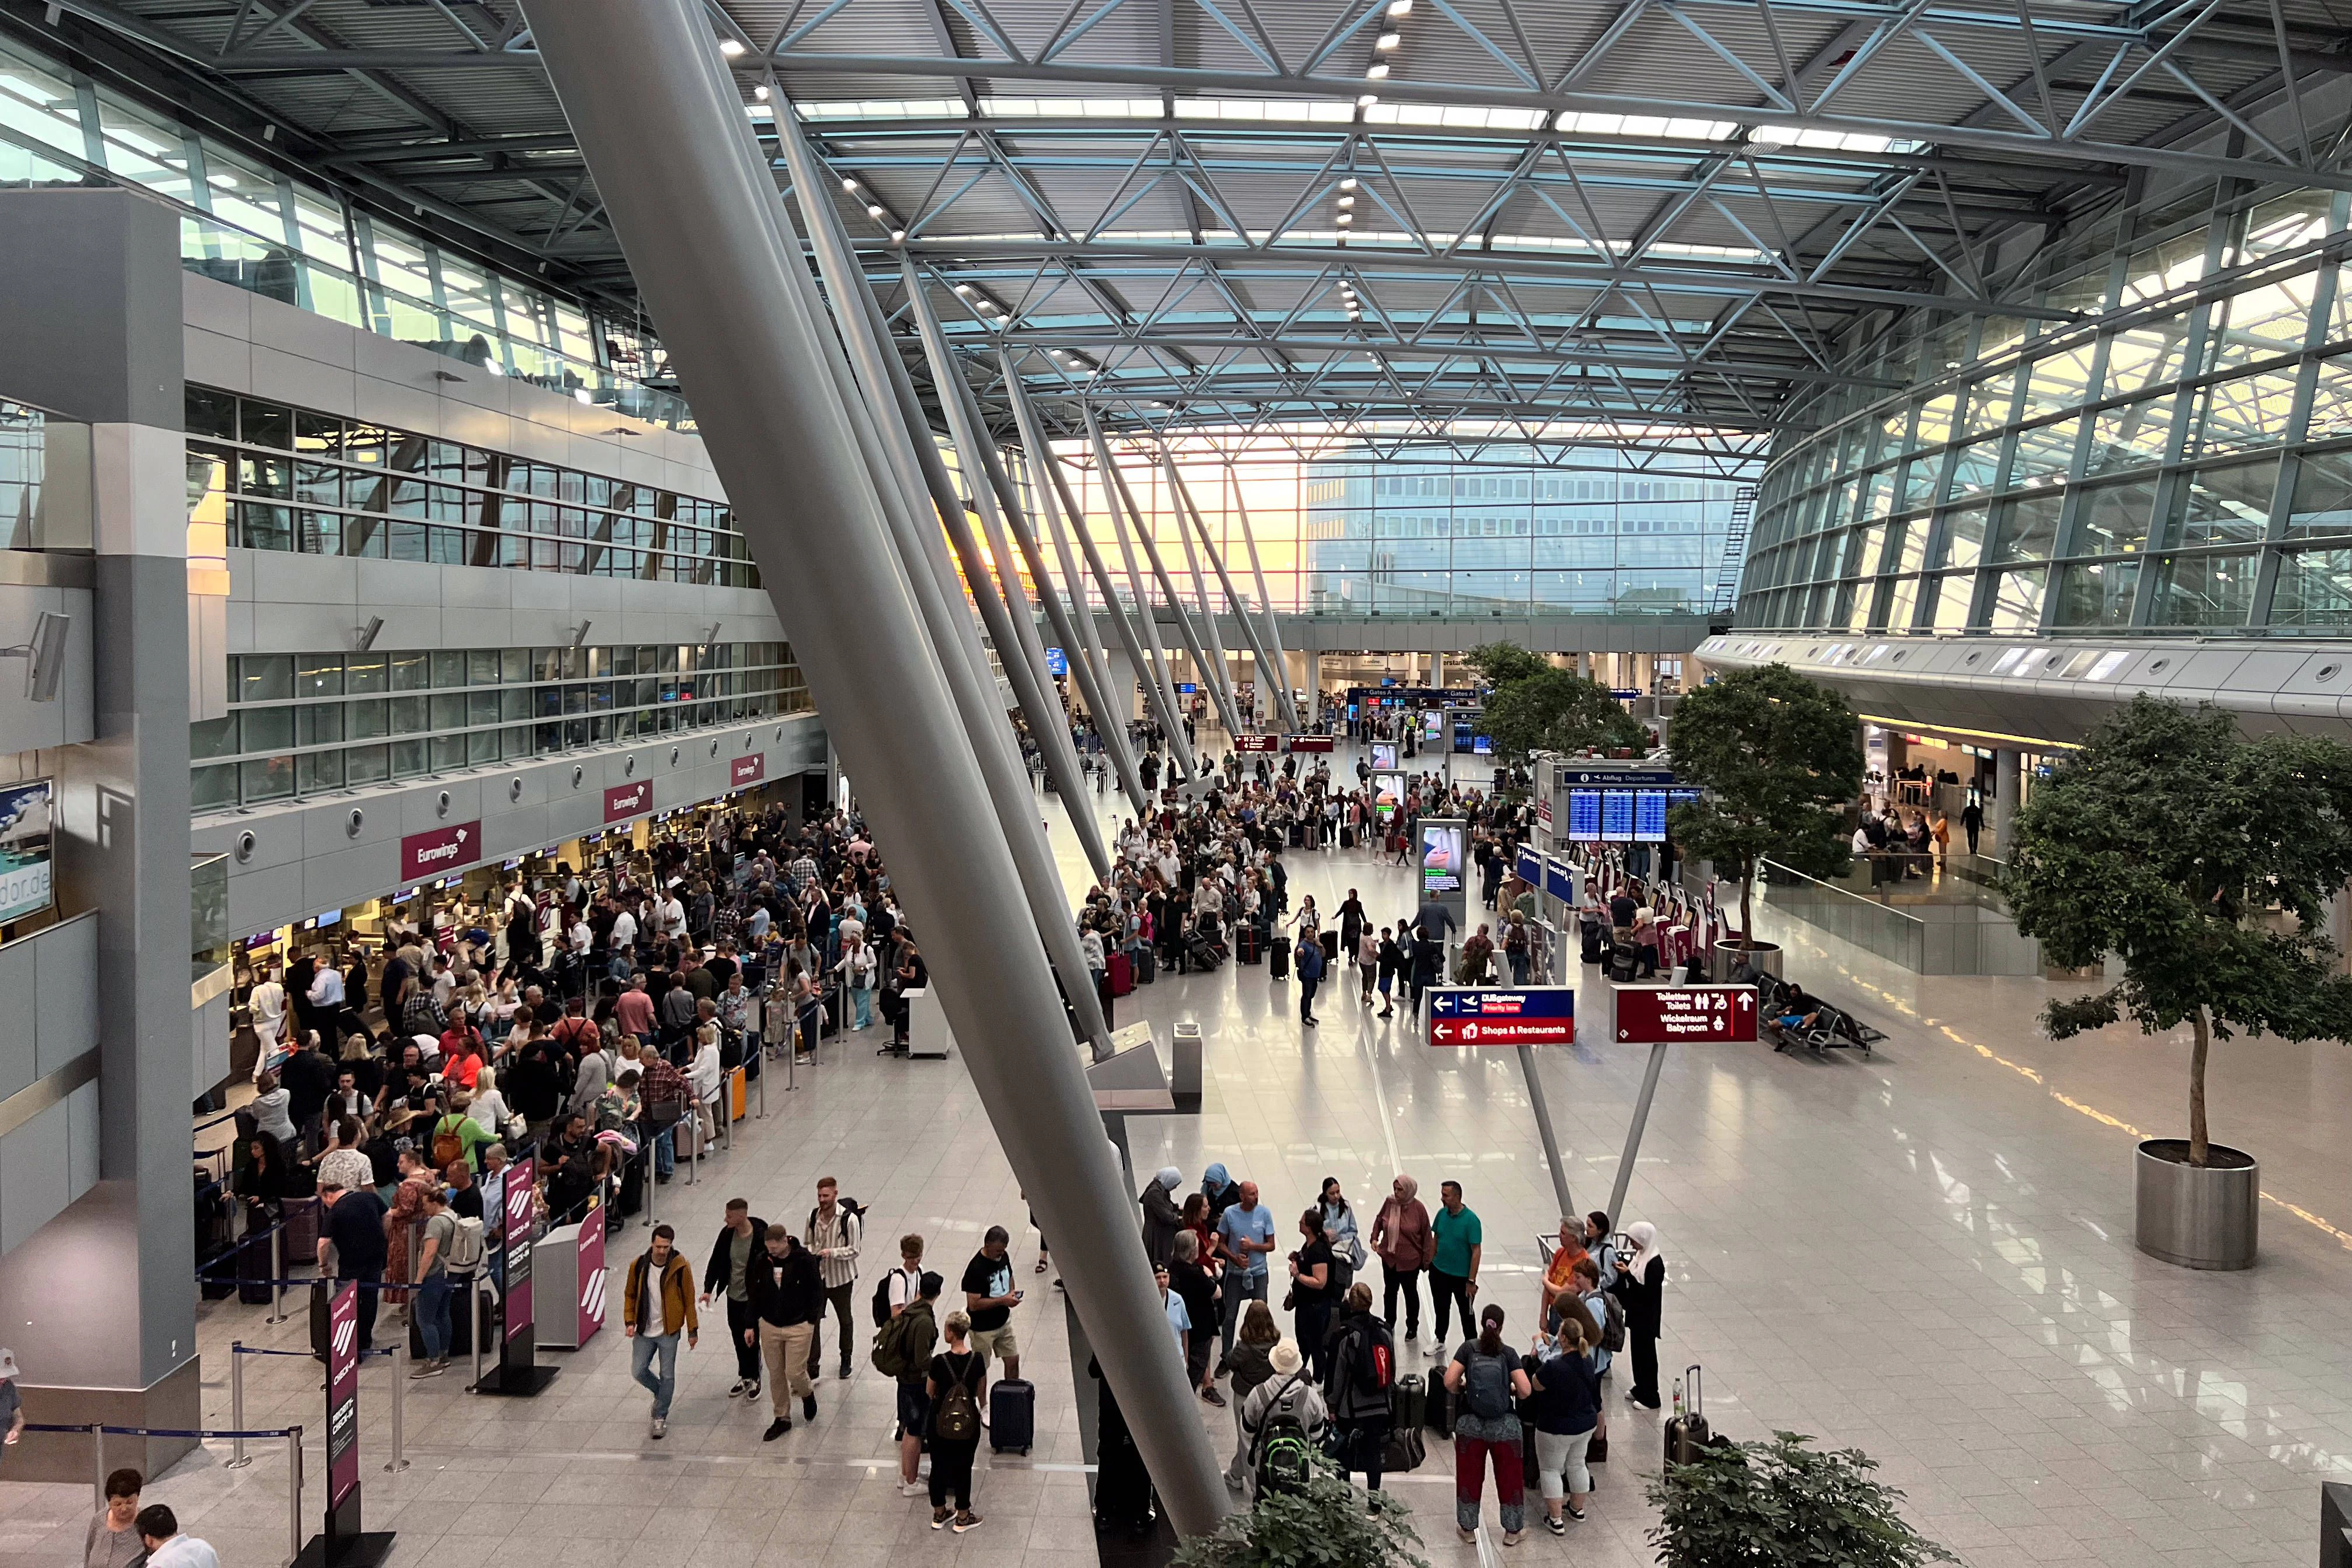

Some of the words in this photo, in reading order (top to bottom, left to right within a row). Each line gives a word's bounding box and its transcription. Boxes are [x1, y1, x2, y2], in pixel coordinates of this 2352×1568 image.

[614, 795, 639, 810] Eurowings
[418, 843, 458, 863] Eurowings
[1656, 992, 1691, 1001] Toiletten
[1666, 1002, 1691, 1010] Toilets
[1660, 1014, 1708, 1023] Wickelraum
[1482, 1026, 1507, 1036] Shops
[1509, 1026, 1516, 1034] &
[1517, 1026, 1566, 1034] Restaurants
[1666, 1023, 1686, 1034] Baby
